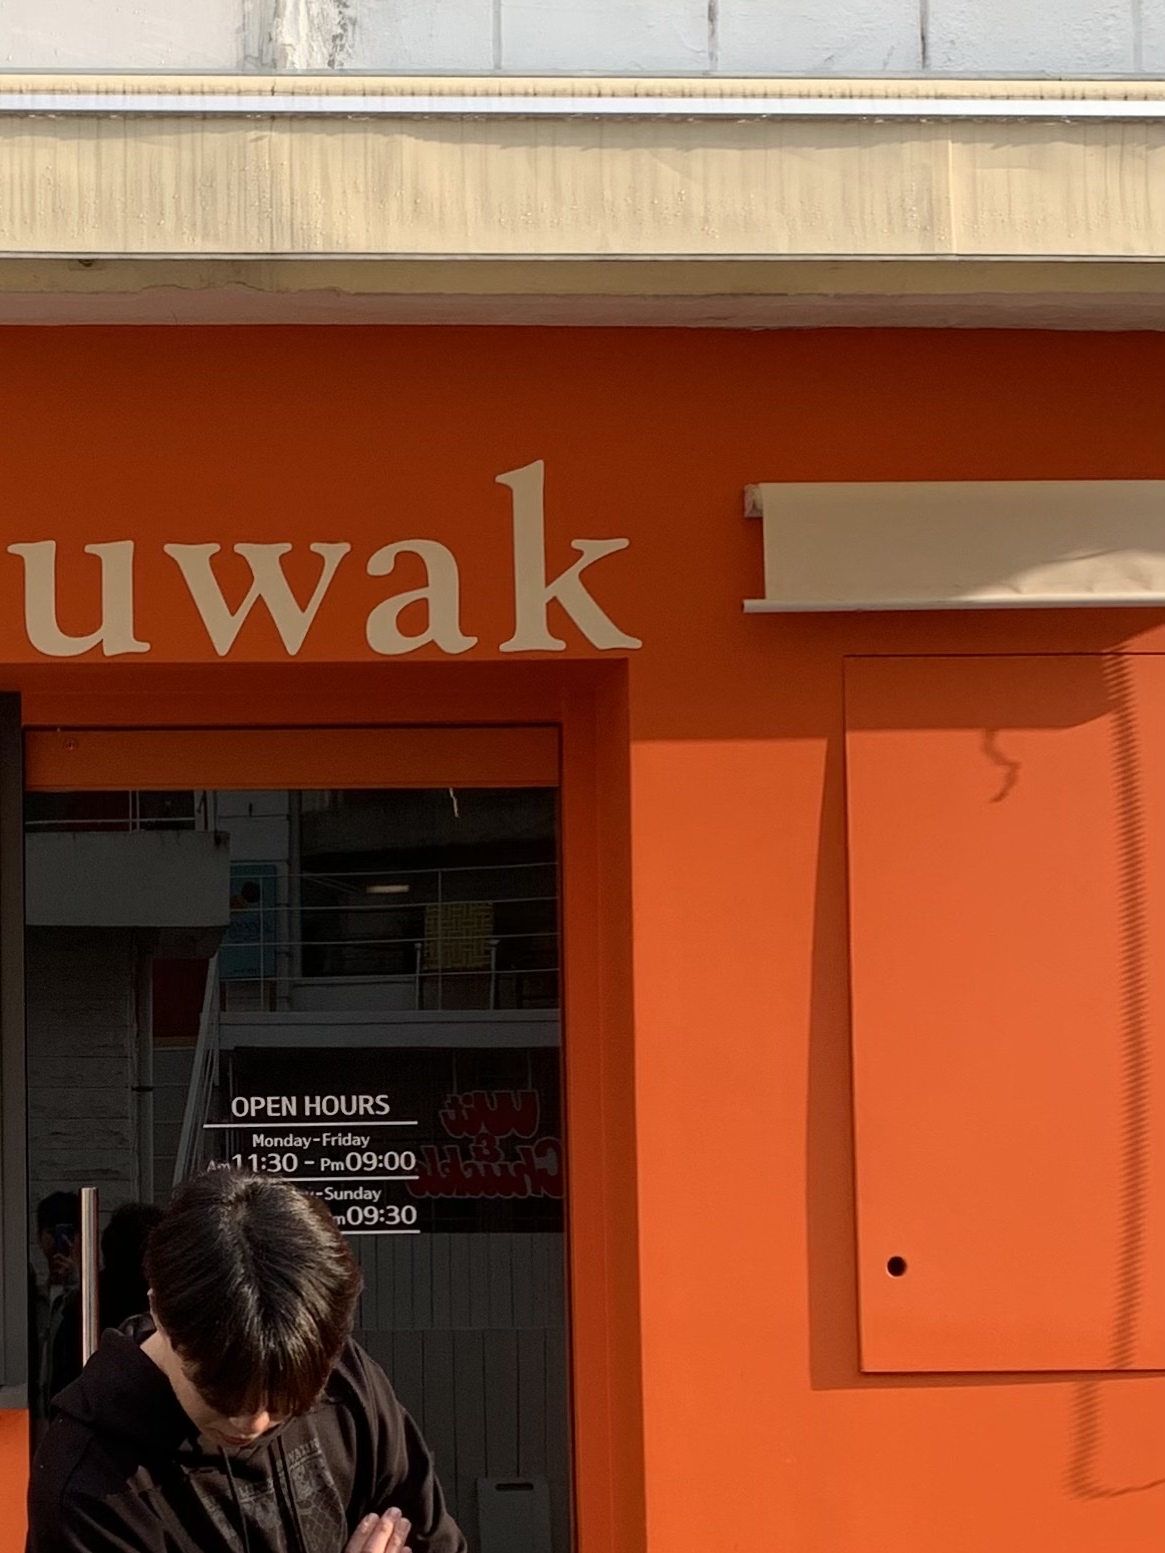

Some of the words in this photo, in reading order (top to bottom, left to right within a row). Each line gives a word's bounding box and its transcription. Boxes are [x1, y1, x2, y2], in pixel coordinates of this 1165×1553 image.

[231, 1095, 297, 1117] OPEN
[304, 1094, 391, 1116] HOURS
[251, 1132, 371, 1149] Monday-Friday
